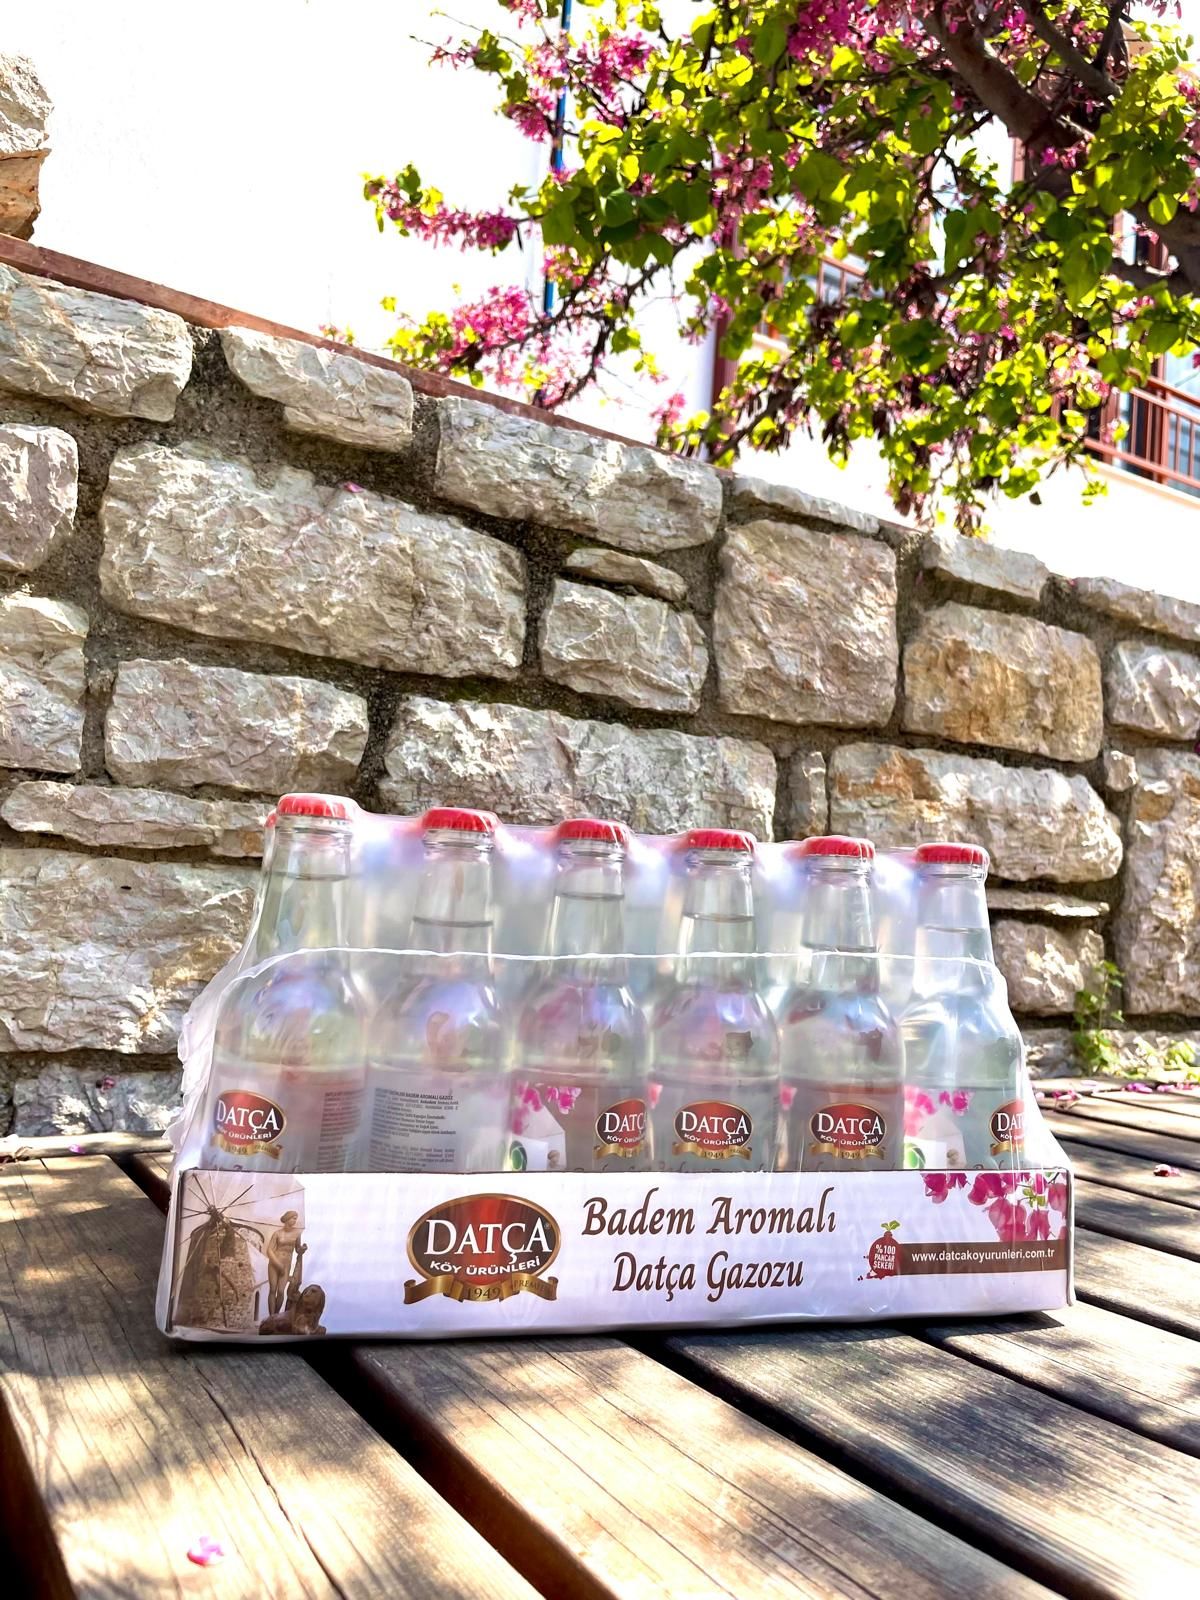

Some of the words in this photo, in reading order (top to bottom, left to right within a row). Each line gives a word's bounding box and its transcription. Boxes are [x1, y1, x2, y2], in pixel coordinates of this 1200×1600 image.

[216, 1099, 281, 1135] DATÇA
[681, 1111, 749, 1141] DATÇA
[816, 1112, 883, 1141] DATÇA
[228, 1131, 272, 1140] ÜRÜNLERİ
[684, 1133, 701, 1142] KÖY
[703, 1136, 744, 1146] ÜRÜNLERİ
[820, 1134, 838, 1143] KÖY
[840, 1136, 879, 1146] ÜRÜNLERİ
[704, 1151, 723, 1159] 1949
[581, 1187, 695, 1236] Badem
[706, 1186, 836, 1235] Aromalı
[424, 1217, 552, 1264] DATÇA
[874, 1254, 895, 1263] PANCAR
[912, 1248, 1055, 1263] www.datcakoyurunleri.com.tr
[430, 1260, 462, 1274] KÖY
[466, 1256, 541, 1275] ÜRÜNLERİ
[612, 1251, 697, 1302] Datça
[706, 1250, 804, 1302] Gazozu
[466, 1286, 501, 1300] 1949
